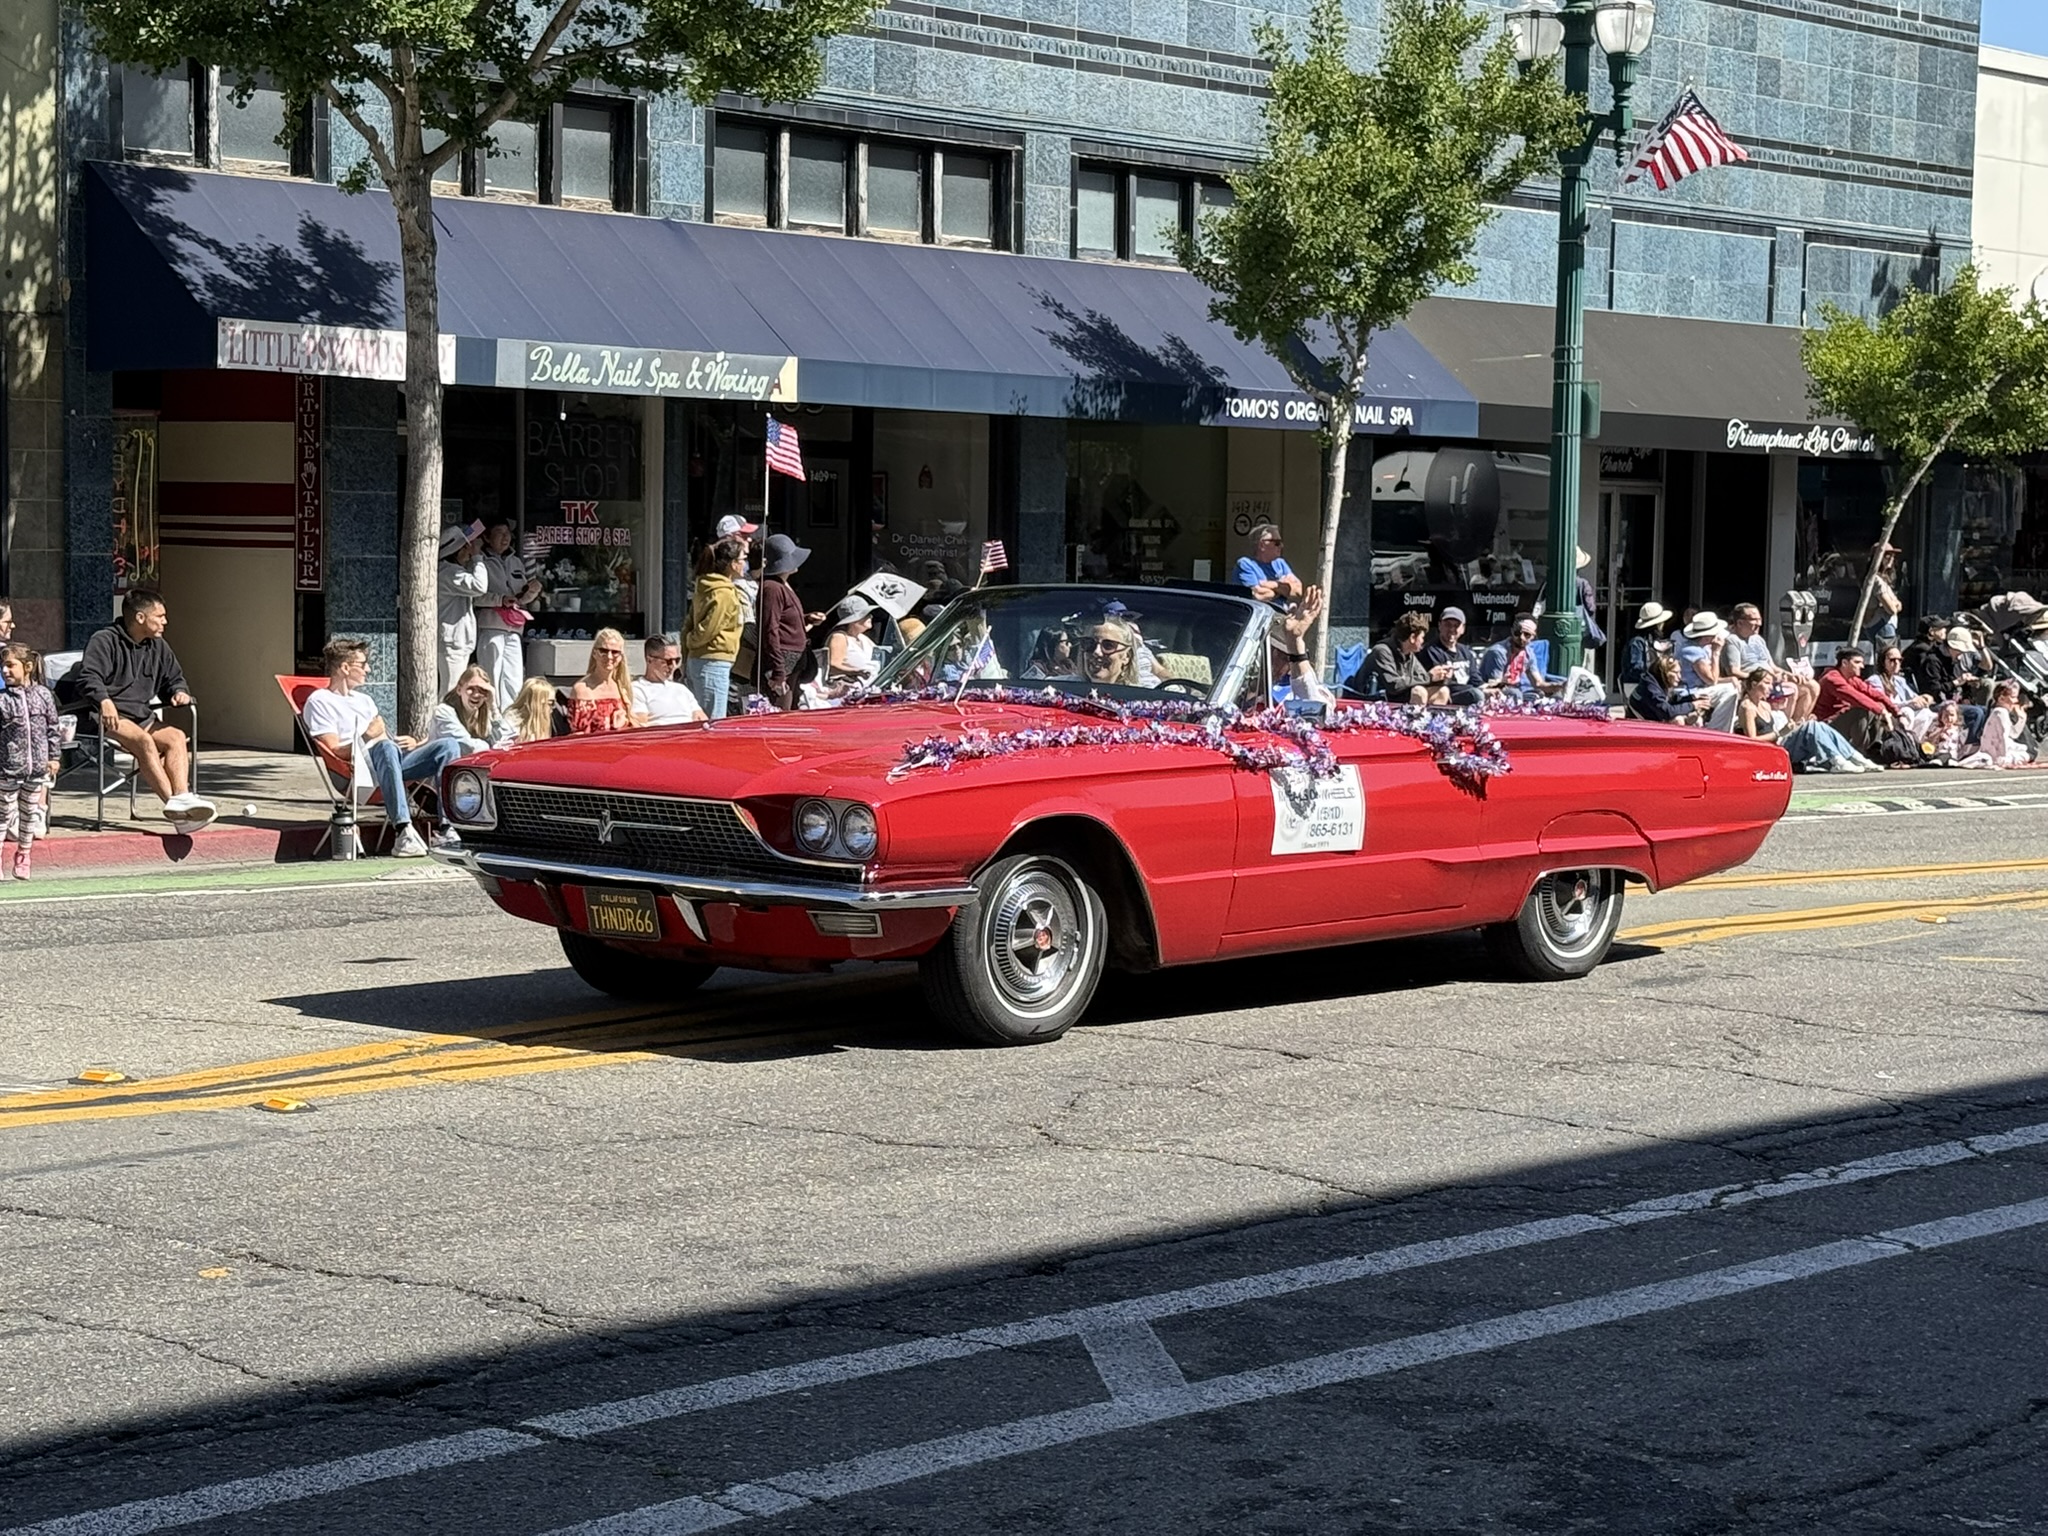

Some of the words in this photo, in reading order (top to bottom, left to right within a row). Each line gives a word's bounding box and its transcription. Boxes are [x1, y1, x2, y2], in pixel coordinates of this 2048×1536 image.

[228, 328, 300, 368] LITTLE
[530, 345, 591, 383] Bella
[592, 350, 643, 388] Nail
[645, 357, 681, 392] Spa
[686, 356, 703, 391] &
[704, 360, 770, 401] Waxing
[302, 375, 317, 459] RTUNE
[1225, 397, 1280, 420] TOMO'S
[1285, 400, 1331, 423] ORGA
[1355, 404, 1385, 426] NAIL
[1389, 405, 1414, 427] SPA
[527, 420, 637, 459] BARBER
[1726, 417, 1804, 454] Triumphant
[1803, 424, 1830, 457] Life
[544, 462, 620, 498] SHOP
[560, 500, 600, 525] TK
[302, 490, 317, 577] TELLER
[536, 525, 575, 545] BARBER
[576, 526, 602, 546] SHOP
[603, 527, 611, 546] &
[612, 527, 631, 547] SPA
[909, 533, 941, 544] Daniel
[900, 545, 958, 558] Optometrist
[1404, 592, 1436, 608] Sunday
[1472, 592, 1520, 607] Wednesday
[1486, 609, 1491, 621] 7
[1492, 610, 1506, 624] pm
[1309, 821, 1354, 838] 865-6131
[590, 905, 654, 933] THNDR66
